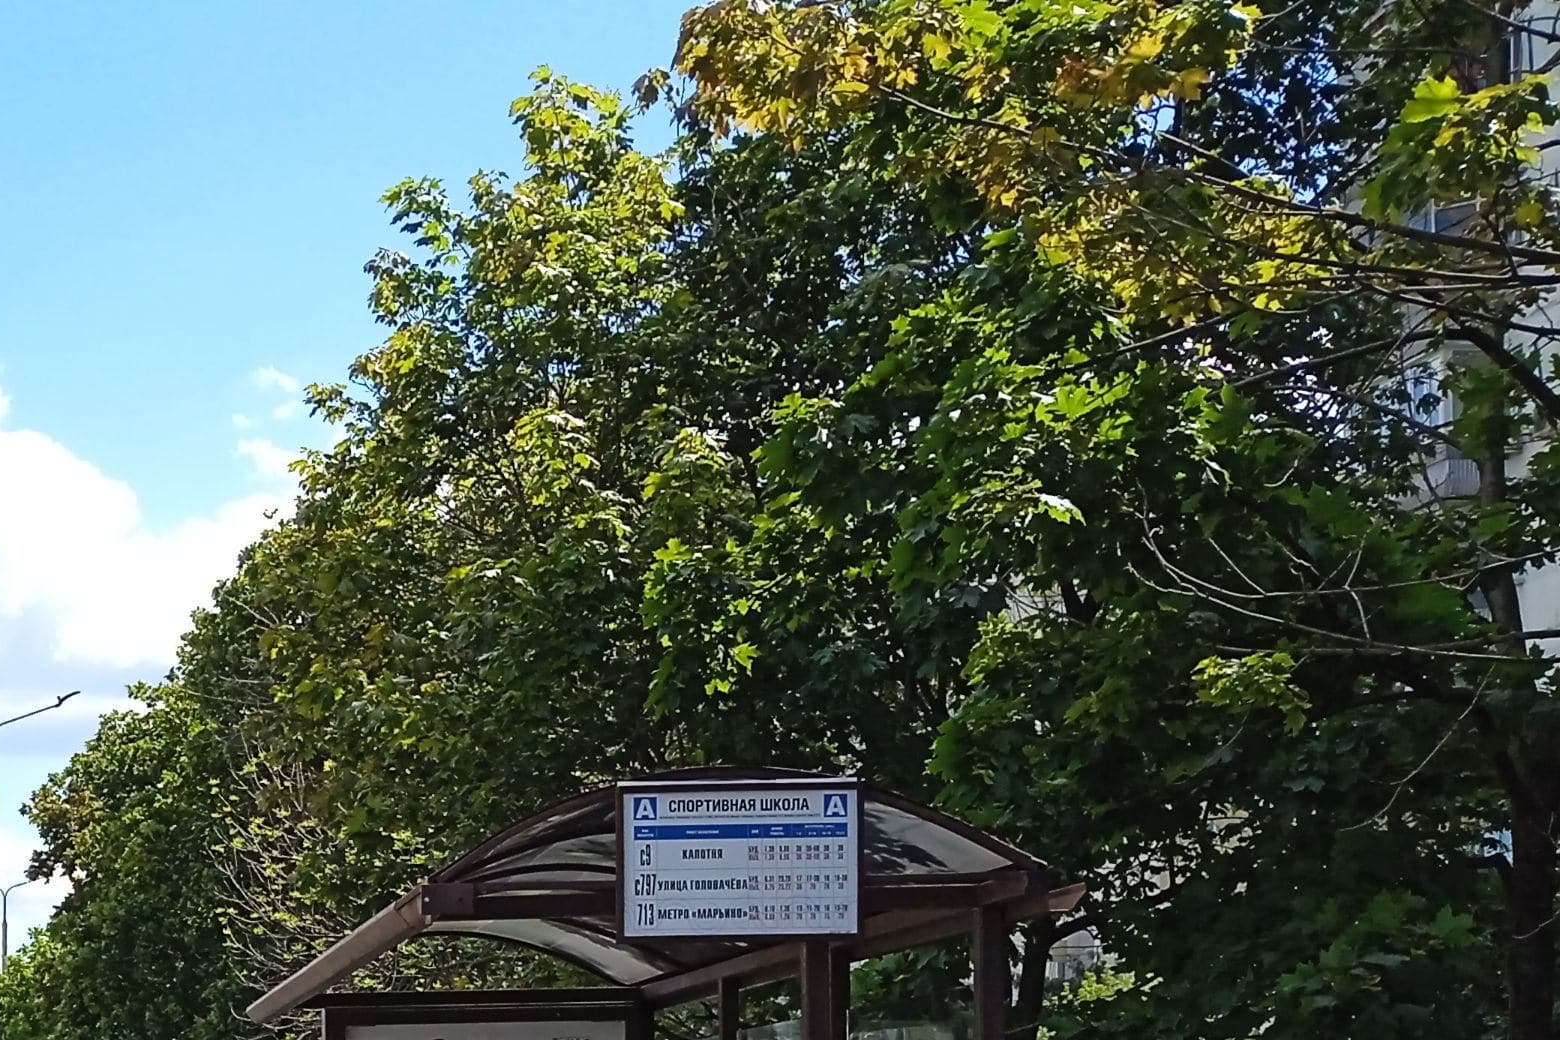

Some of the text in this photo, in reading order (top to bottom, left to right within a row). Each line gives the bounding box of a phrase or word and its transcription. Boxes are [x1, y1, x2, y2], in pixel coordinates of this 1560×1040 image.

[668, 797, 810, 813] СПОРТИВНАЯ ШКОЛА
[682, 848, 723, 860] КАПОТНЯ
[657, 880, 689, 892] УЛИЦА
[690, 876, 749, 891] ГОЛОВАЧЁВА
[637, 903, 655, 926] 713
[657, 909, 690, 920] МЕТРО
[691, 908, 748, 919] «МАРЬИНО»
